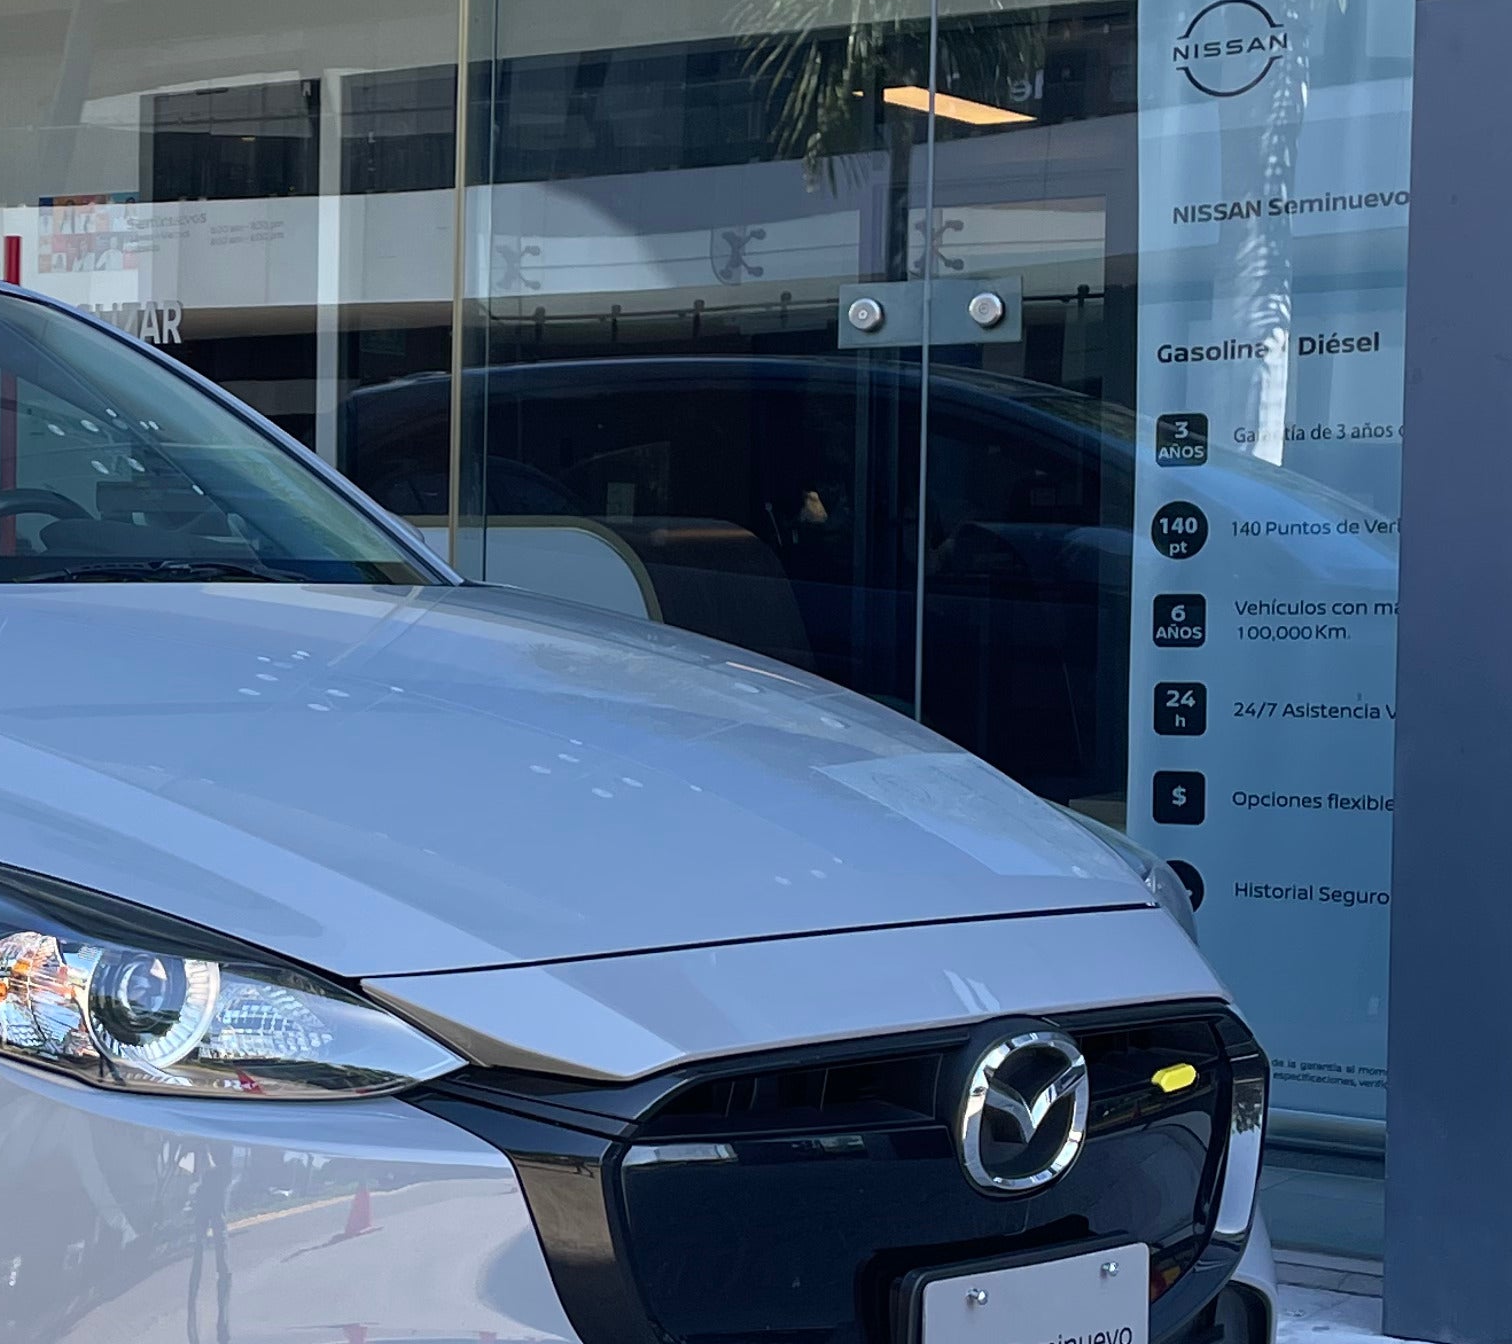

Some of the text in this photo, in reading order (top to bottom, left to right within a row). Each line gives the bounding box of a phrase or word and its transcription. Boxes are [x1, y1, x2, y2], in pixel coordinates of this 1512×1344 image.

[1173, 33, 1287, 61] NISSAN
[1173, 200, 1261, 224] NISSAN
[1298, 331, 1380, 356] Diésel
[1174, 421, 1189, 439] 3
[1310, 423, 1333, 441] de
[1336, 423, 1347, 440] 3
[1350, 422, 1394, 439] años
[1158, 443, 1205, 459] AÑOS
[1159, 516, 1199, 534] 140
[1231, 520, 1261, 537] 140
[1265, 519, 1331, 536] Puntos
[1336, 519, 1360, 535] de
[1168, 540, 1188, 556] pt
[1170, 604, 1186, 623] 6
[1234, 598, 1326, 616] Vehículos
[1331, 603, 1368, 616] con
[1155, 623, 1203, 640] AÑOS
[1237, 625, 1311, 642] 100,000
[1165, 689, 1196, 708] 24
[1233, 701, 1278, 719] 24/7
[1282, 702, 1381, 720] Asistencia
[1175, 713, 1186, 728] h
[1232, 790, 1323, 810] Opciones
[1234, 882, 1390, 907] Historial Seguro
